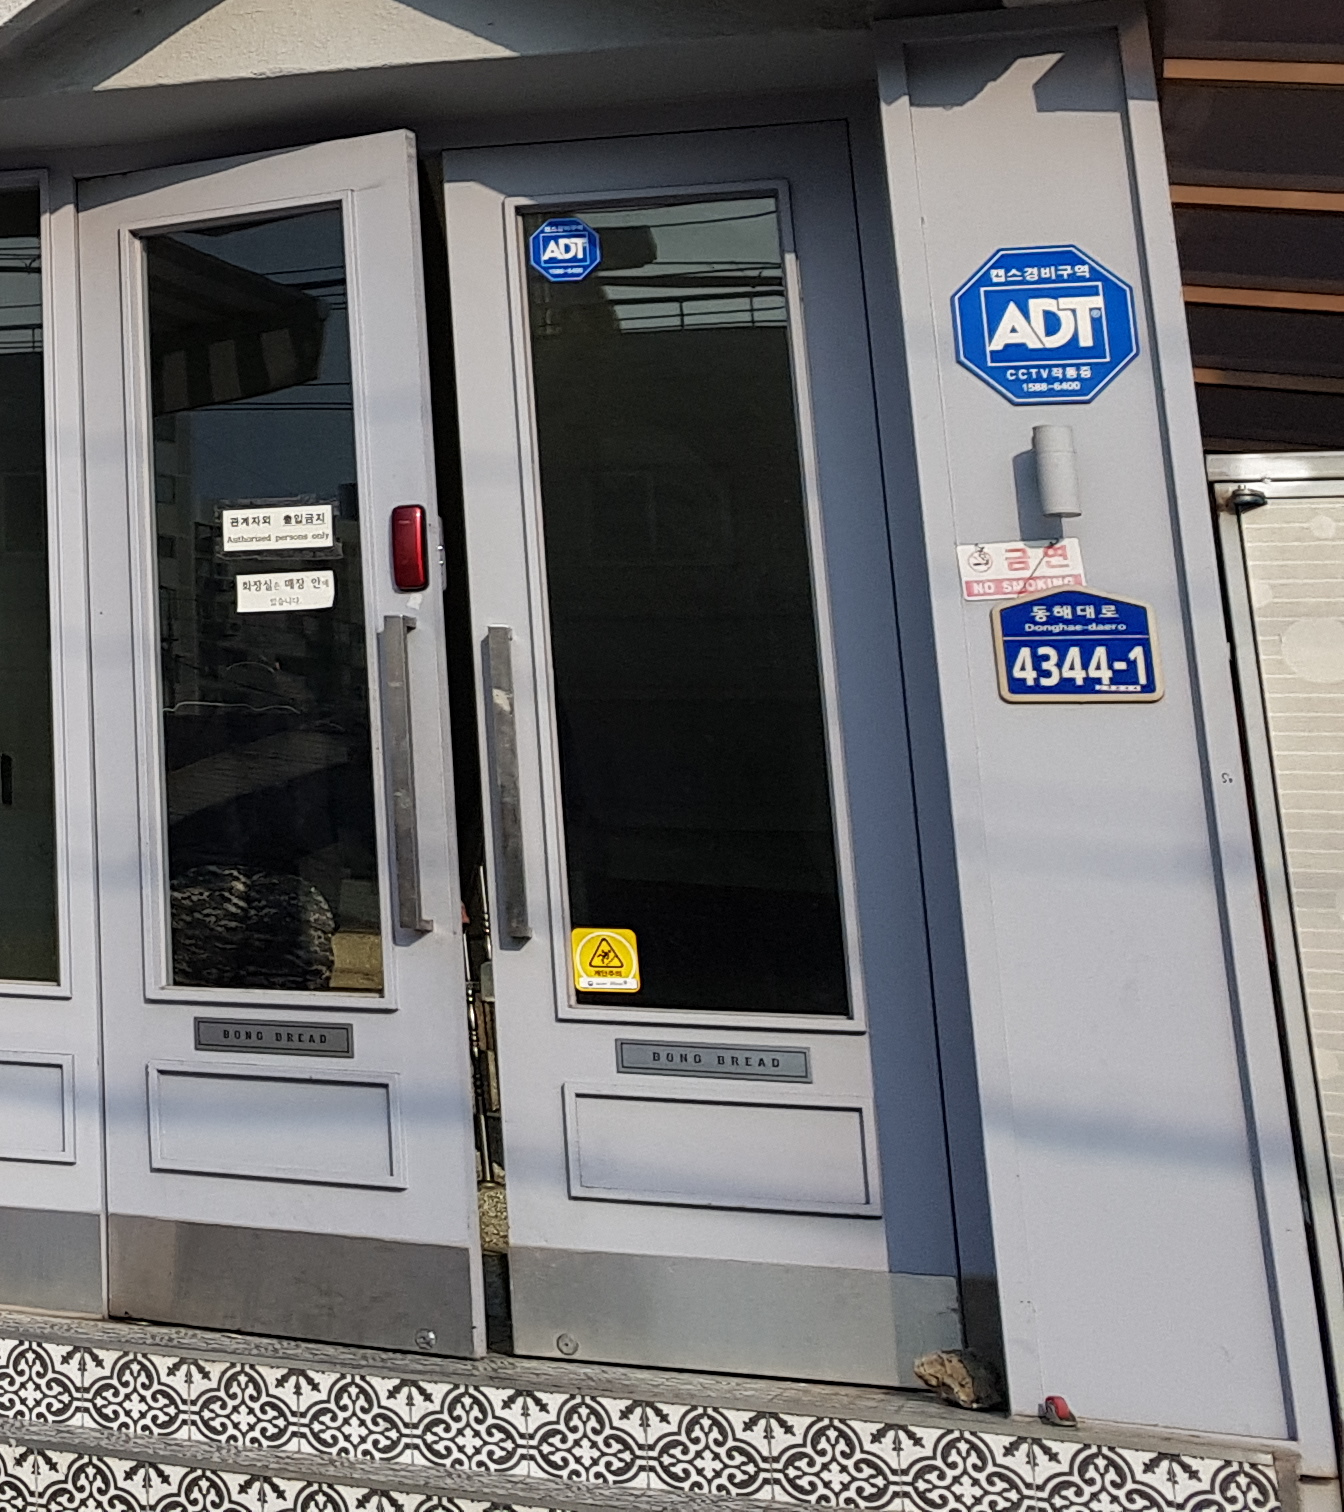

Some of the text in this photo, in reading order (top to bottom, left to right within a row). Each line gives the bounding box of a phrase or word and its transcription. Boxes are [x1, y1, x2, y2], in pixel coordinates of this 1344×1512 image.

[542, 237, 587, 260] ADT
[990, 264, 1090, 283] 캡스경비구역
[989, 295, 1103, 351] ADT
[275, 533, 308, 542] persons
[312, 532, 329, 540] only
[1005, 544, 1070, 572] 금연
[973, 582, 995, 595] NO
[1030, 605, 1119, 622] 동해대로
[1024, 623, 1127, 633] Donghae-daero
[1012, 645, 1147, 687] 4344-1
[275, 1032, 327, 1044] BREAD
[717, 1055, 780, 1068] BREAD
